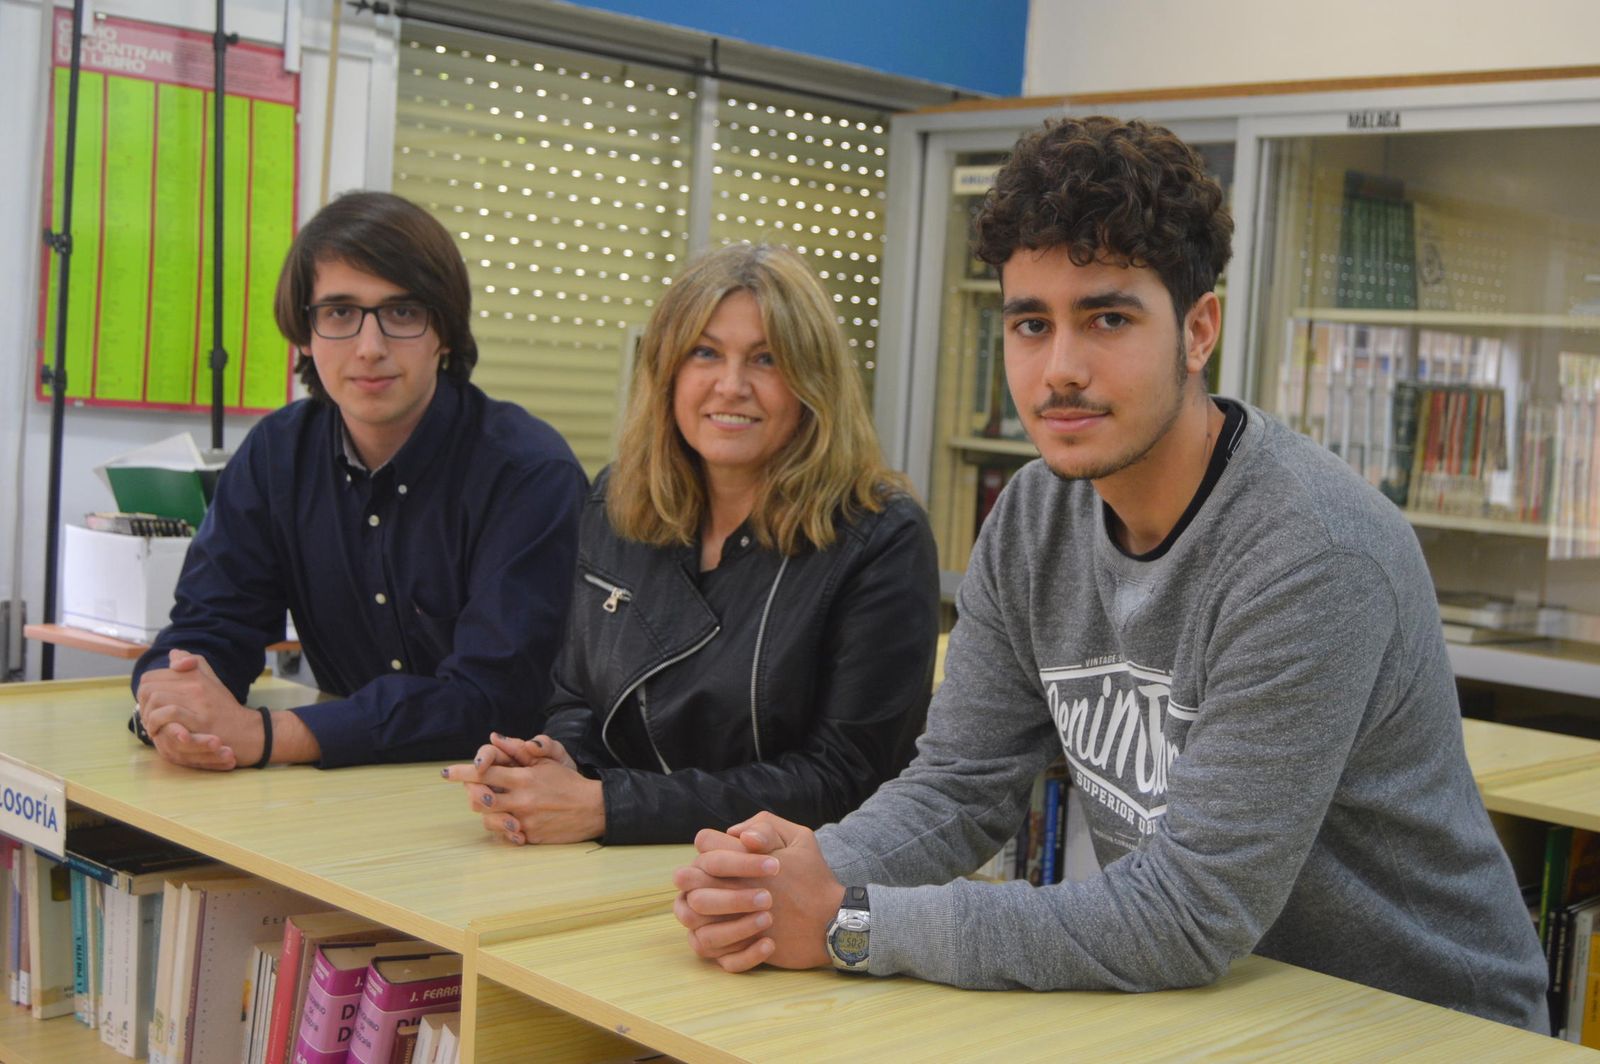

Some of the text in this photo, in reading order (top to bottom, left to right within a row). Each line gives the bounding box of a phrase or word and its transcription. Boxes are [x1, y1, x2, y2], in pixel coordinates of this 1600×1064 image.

[1085, 655, 1117, 668] VINTAGE
[0, 788, 58, 833] OSOFÍA
[1076, 771, 1136, 826] SUPERIOR
[410, 991, 419, 1003] J.
